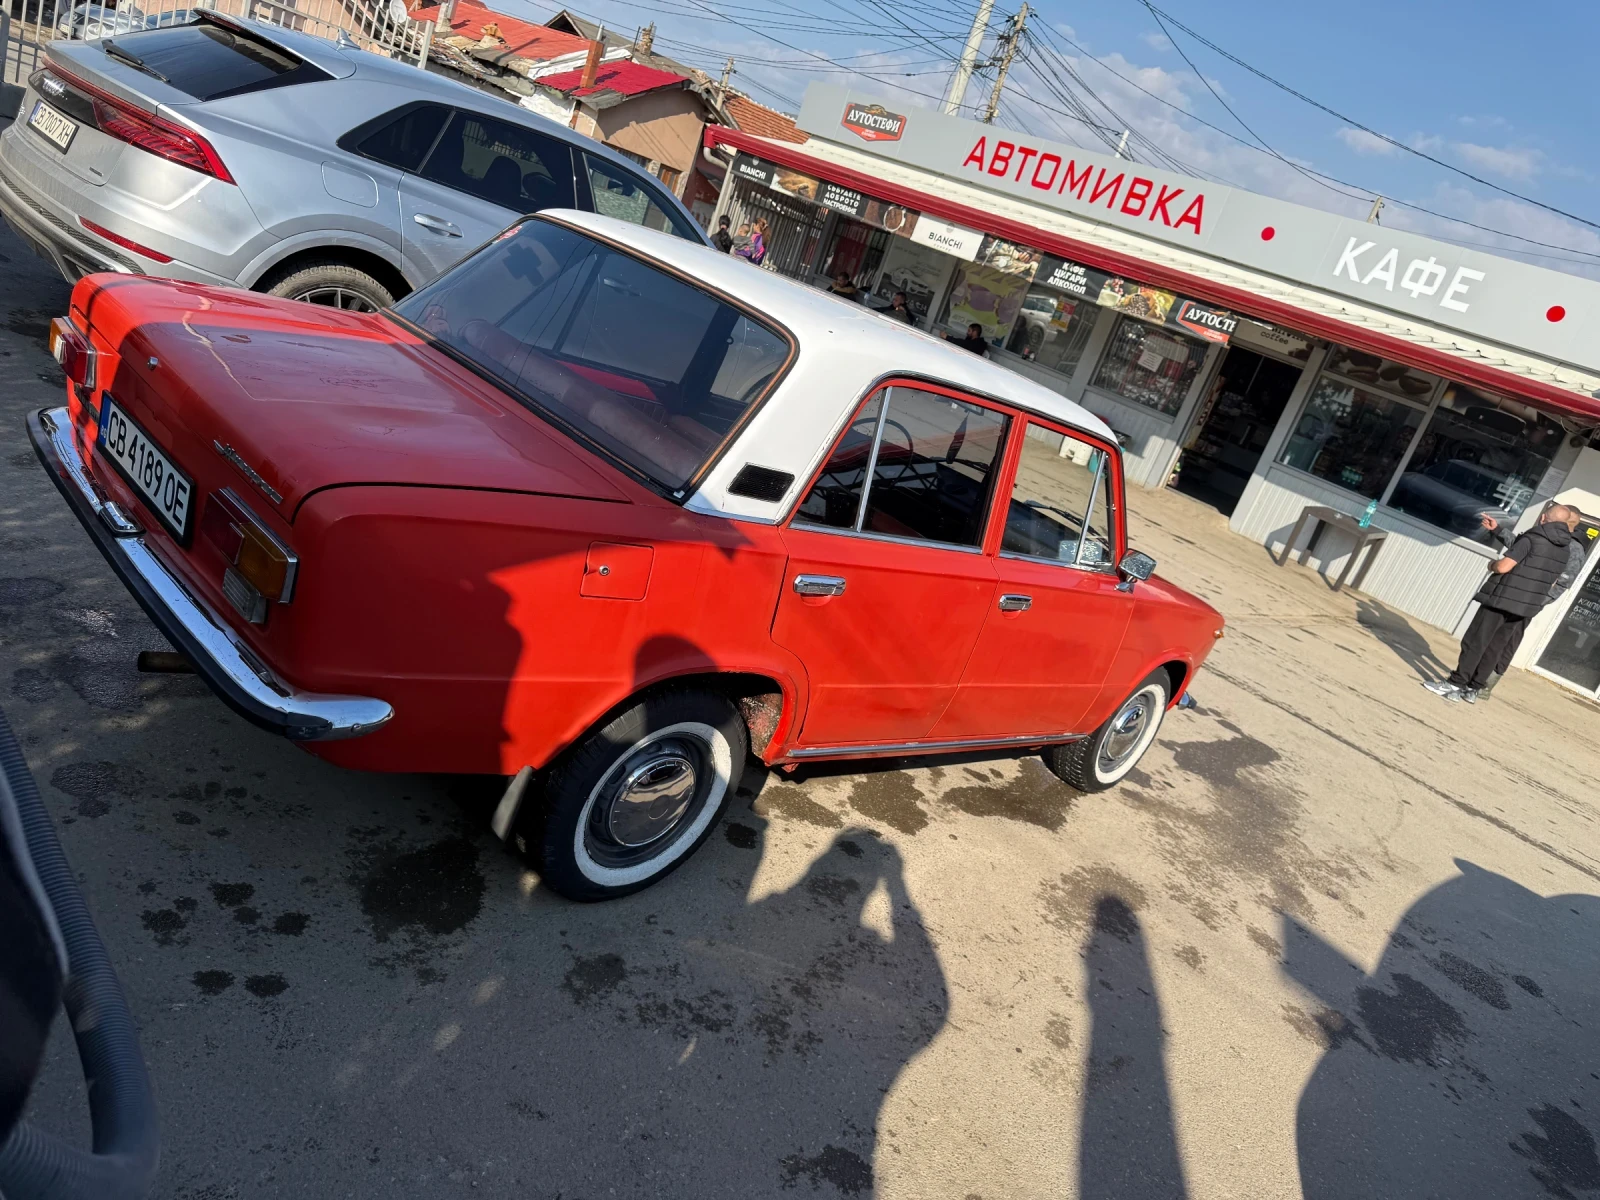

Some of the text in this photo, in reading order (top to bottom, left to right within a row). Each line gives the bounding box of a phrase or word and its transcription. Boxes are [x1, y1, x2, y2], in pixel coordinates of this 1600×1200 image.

[847, 109, 901, 133] АУТОСТЕФИ
[57, 122, 74, 144] XH
[740, 164, 767, 180] BIANCHI
[963, 136, 1204, 234] АВТОМИВКА
[824, 191, 859, 208] ДОБРОТО
[928, 232, 963, 250] BIANCHI
[1053, 268, 1087, 285] ЦИГАРИ
[1333, 236, 1486, 314] КАФЕ
[1047, 276, 1087, 295] АЛКОХОЛ
[1261, 331, 1289, 346] coffee
[108, 411, 188, 527] CB 4189 OE
